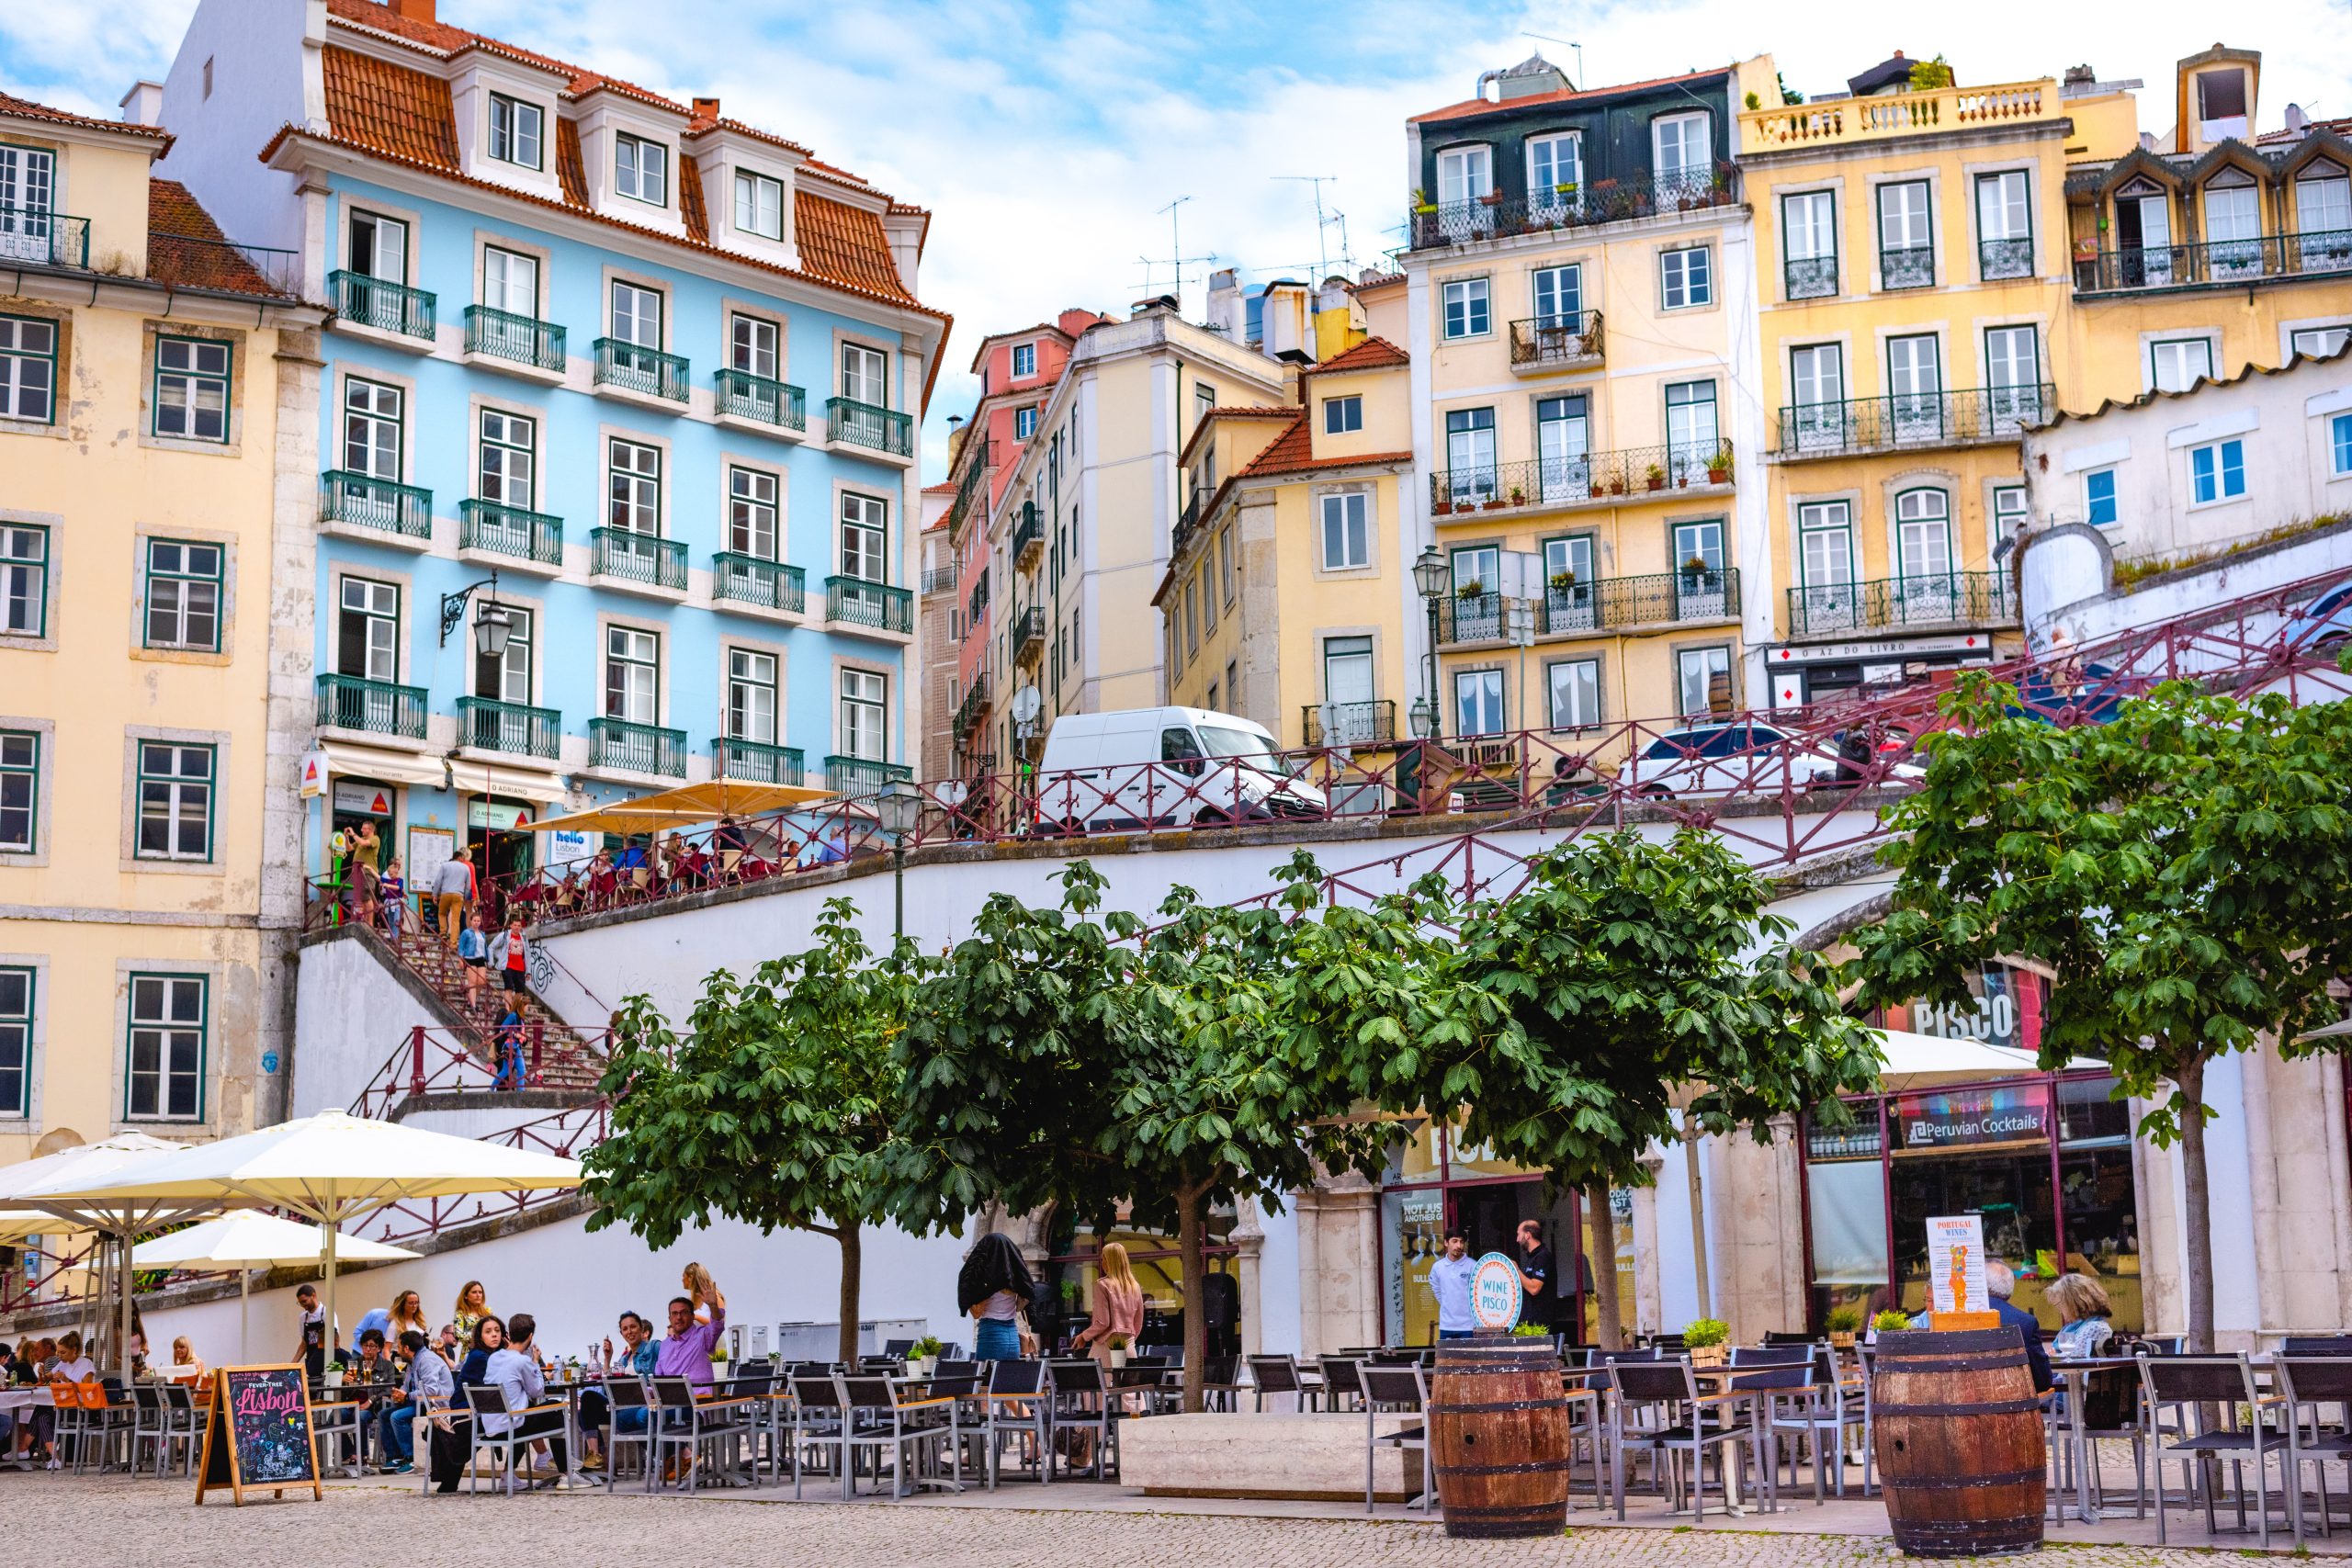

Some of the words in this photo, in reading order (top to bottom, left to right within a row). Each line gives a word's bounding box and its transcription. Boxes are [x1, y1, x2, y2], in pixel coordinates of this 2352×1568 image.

[1820, 649, 1833, 657] AZ
[1844, 647, 1859, 655] DO
[1870, 643, 1905, 653] LIVRO
[371, 768, 403, 779] Restaurante
[498, 785, 528, 795] ADRIANO
[342, 793, 366, 801] ADRIANO
[481, 810, 503, 818] ADRIANO
[556, 830, 584, 844] hello
[556, 843, 581, 854] Lisbon
[1914, 994, 2014, 1040] PISCO
[1927, 1122, 1979, 1138] Peruvian
[1982, 1114, 2038, 1134] Cocktails
[1609, 1189, 1633, 1199] ODKA
[1404, 1204, 1423, 1215] NOT
[1425, 1202, 1442, 1213] JUS
[1610, 1198, 1627, 1208] AST
[1404, 1213, 1435, 1223] ANOTHER
[1937, 1220, 1973, 1229] PORTUGAL
[1945, 1228, 1968, 1236] WINES
[1483, 1279, 1509, 1295] WINE
[1482, 1296, 1507, 1312] PISCO
[236, 1387, 305, 1417] Lisbon
